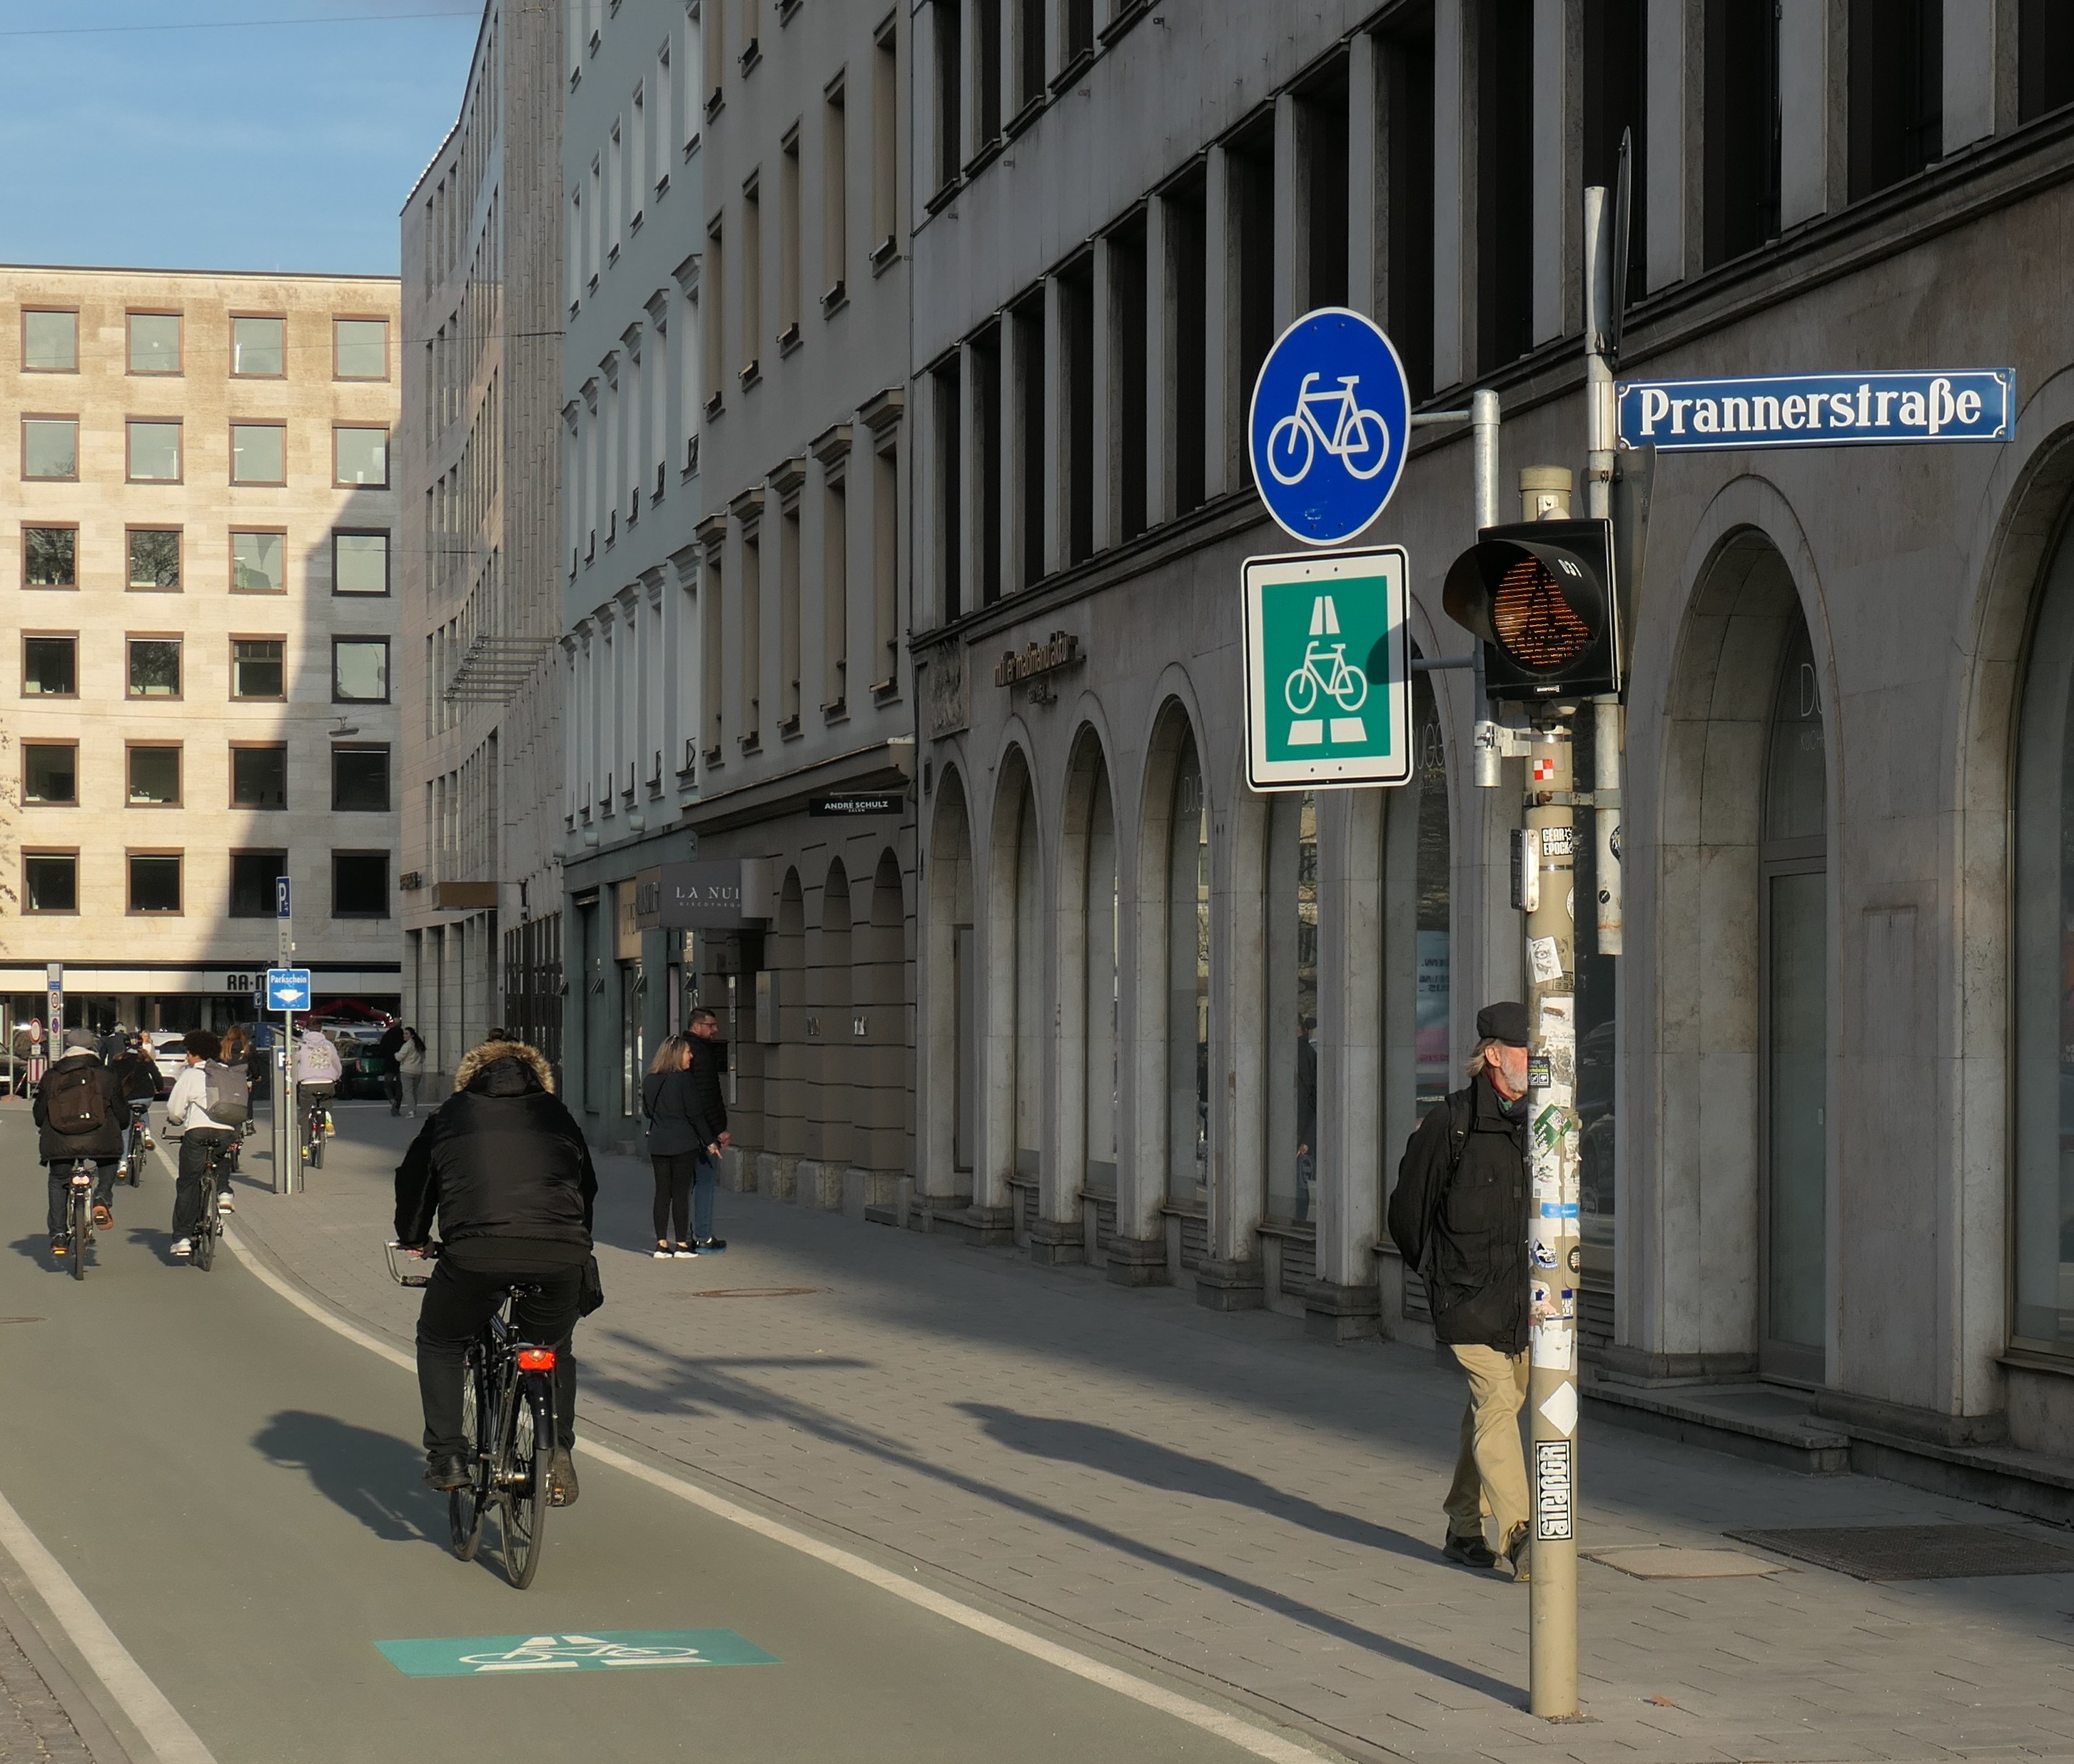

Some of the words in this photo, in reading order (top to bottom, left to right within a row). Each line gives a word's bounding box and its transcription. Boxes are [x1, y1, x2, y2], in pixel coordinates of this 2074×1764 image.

[1640, 378, 1982, 435] Prannerstraße
[824, 800, 854, 810] ANDRÉ
[1542, 828, 1565, 843] GEAR
[278, 883, 286, 913] P
[676, 886, 699, 899] LA
[270, 974, 307, 983] Parkschein
